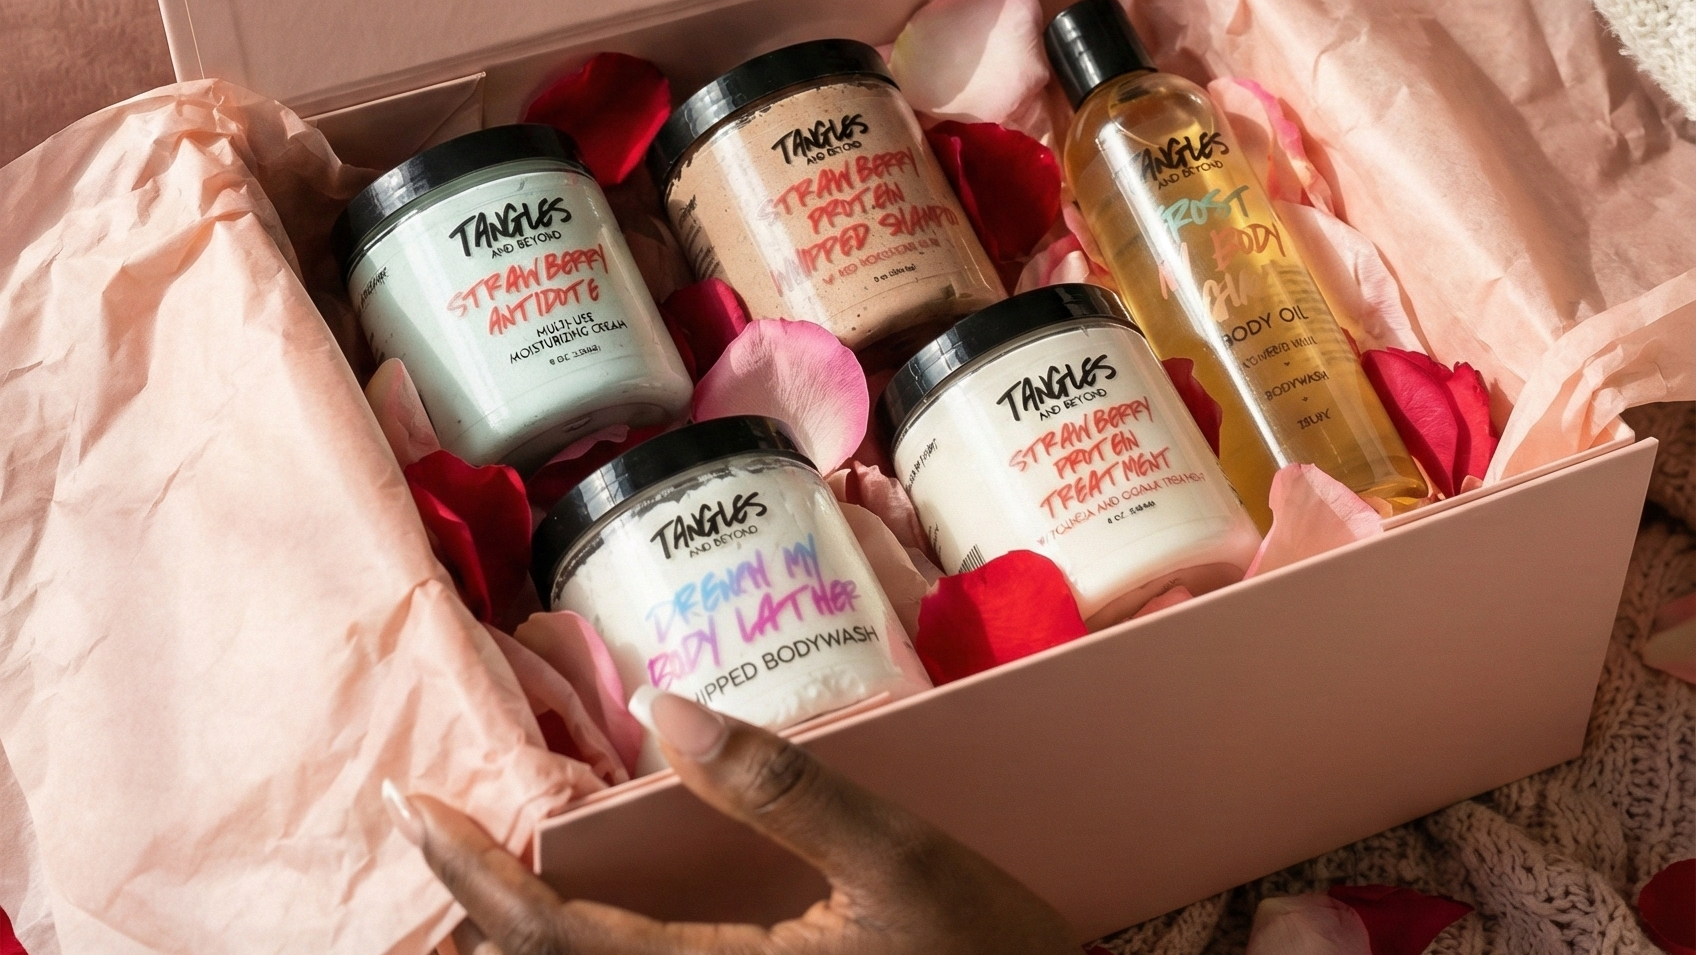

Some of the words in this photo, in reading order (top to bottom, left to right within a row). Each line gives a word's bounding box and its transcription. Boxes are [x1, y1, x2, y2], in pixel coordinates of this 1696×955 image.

[771, 114, 869, 165] TANGLES
[1158, 173, 1179, 190] AND
[449, 197, 573, 257] TANGLES
[491, 242, 514, 260] AND
[516, 230, 563, 250] BEYOND
[1210, 221, 1287, 272] BODY
[488, 277, 601, 336] ANTIDOTE
[1279, 305, 1310, 323] OIL
[995, 353, 1118, 423] TANGLES
[1039, 405, 1061, 422] AND
[1063, 388, 1107, 411] BEYOND
[1053, 429, 1140, 479] PROTEIN
[1038, 446, 1172, 520] TREATMENT
[649, 490, 769, 561] TANGLES
[688, 541, 713, 559] AND
[713, 524, 759, 550] BEYOND
[784, 531, 827, 591] MY
[646, 614, 722, 691] BODY
[735, 579, 861, 644] LATHER
[761, 624, 880, 672] BODYWASH
